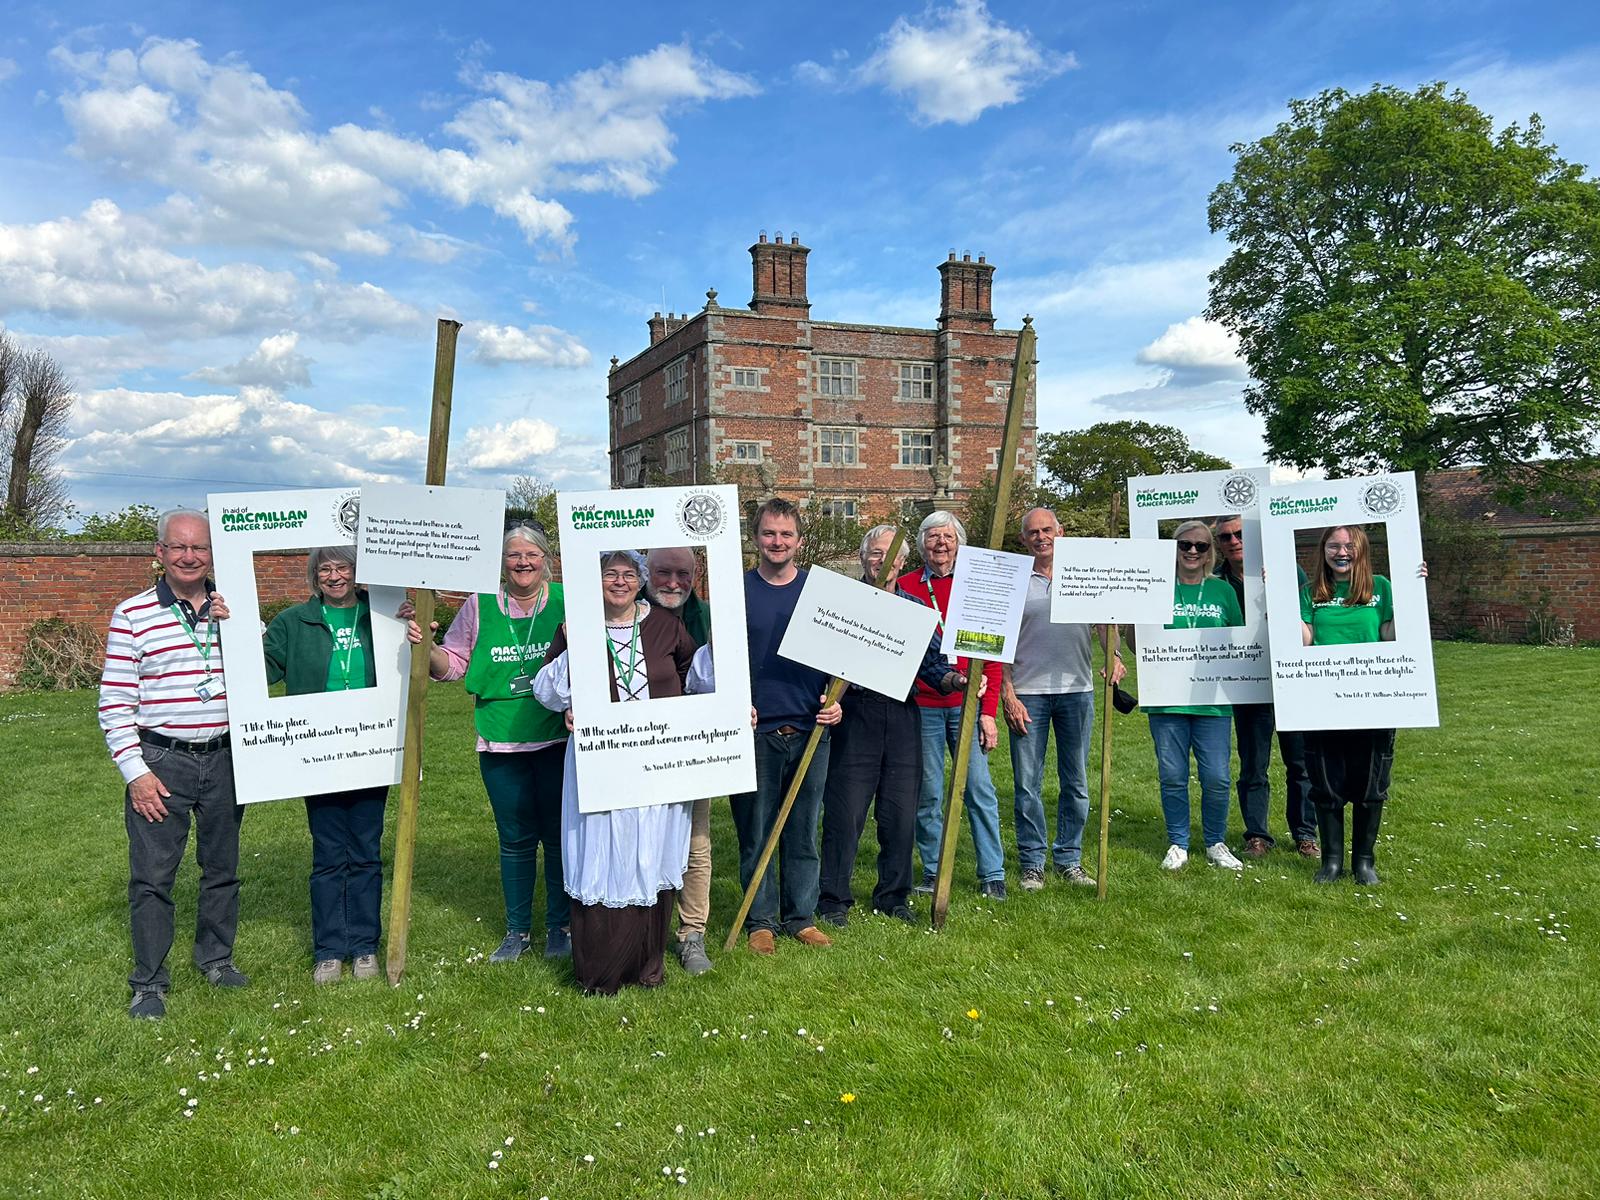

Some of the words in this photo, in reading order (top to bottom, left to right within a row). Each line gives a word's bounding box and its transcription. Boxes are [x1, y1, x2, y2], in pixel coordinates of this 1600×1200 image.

[1136, 490, 1198, 502] MACMILLAN
[1270, 496, 1337, 510] MACMILLAN
[1301, 505, 1334, 513] SUPPORT
[222, 510, 307, 524] MACMILLAN
[572, 508, 654, 522] MACMILLAN
[224, 523, 260, 532] CANCER
[263, 521, 304, 530] SUPPORT
[574, 521, 609, 530] CANCER
[611, 519, 650, 528] SUPPORT
[336, 628, 352, 637] RE
[491, 641, 551, 656] MACMILLA
[524, 650, 546, 660] SUPPO
[1343, 656, 1355, 665] will
[1355, 656, 1374, 668] begin
[1376, 655, 1395, 663] these
[1276, 671, 1285, 679] As
[1295, 670, 1303, 678] do
[1305, 669, 1322, 678] trust
[1324, 669, 1345, 681] they'll
[1369, 667, 1382, 676] true
[250, 722, 264, 731] like
[267, 720, 284, 729] this
[592, 726, 605, 736] the
[637, 725, 643, 733] a
[242, 735, 258, 746] And
[259, 732, 294, 746] willingly
[295, 728, 316, 740] could
[318, 725, 343, 737] waste
[345, 726, 358, 737] my
[359, 722, 376, 731] time
[378, 721, 386, 729] in
[578, 741, 593, 752] And
[595, 739, 606, 750] all
[607, 738, 620, 749] the
[622, 740, 638, 748] men
[640, 735, 655, 747] and
[657, 736, 682, 744] women
[684, 730, 709, 744] merely
